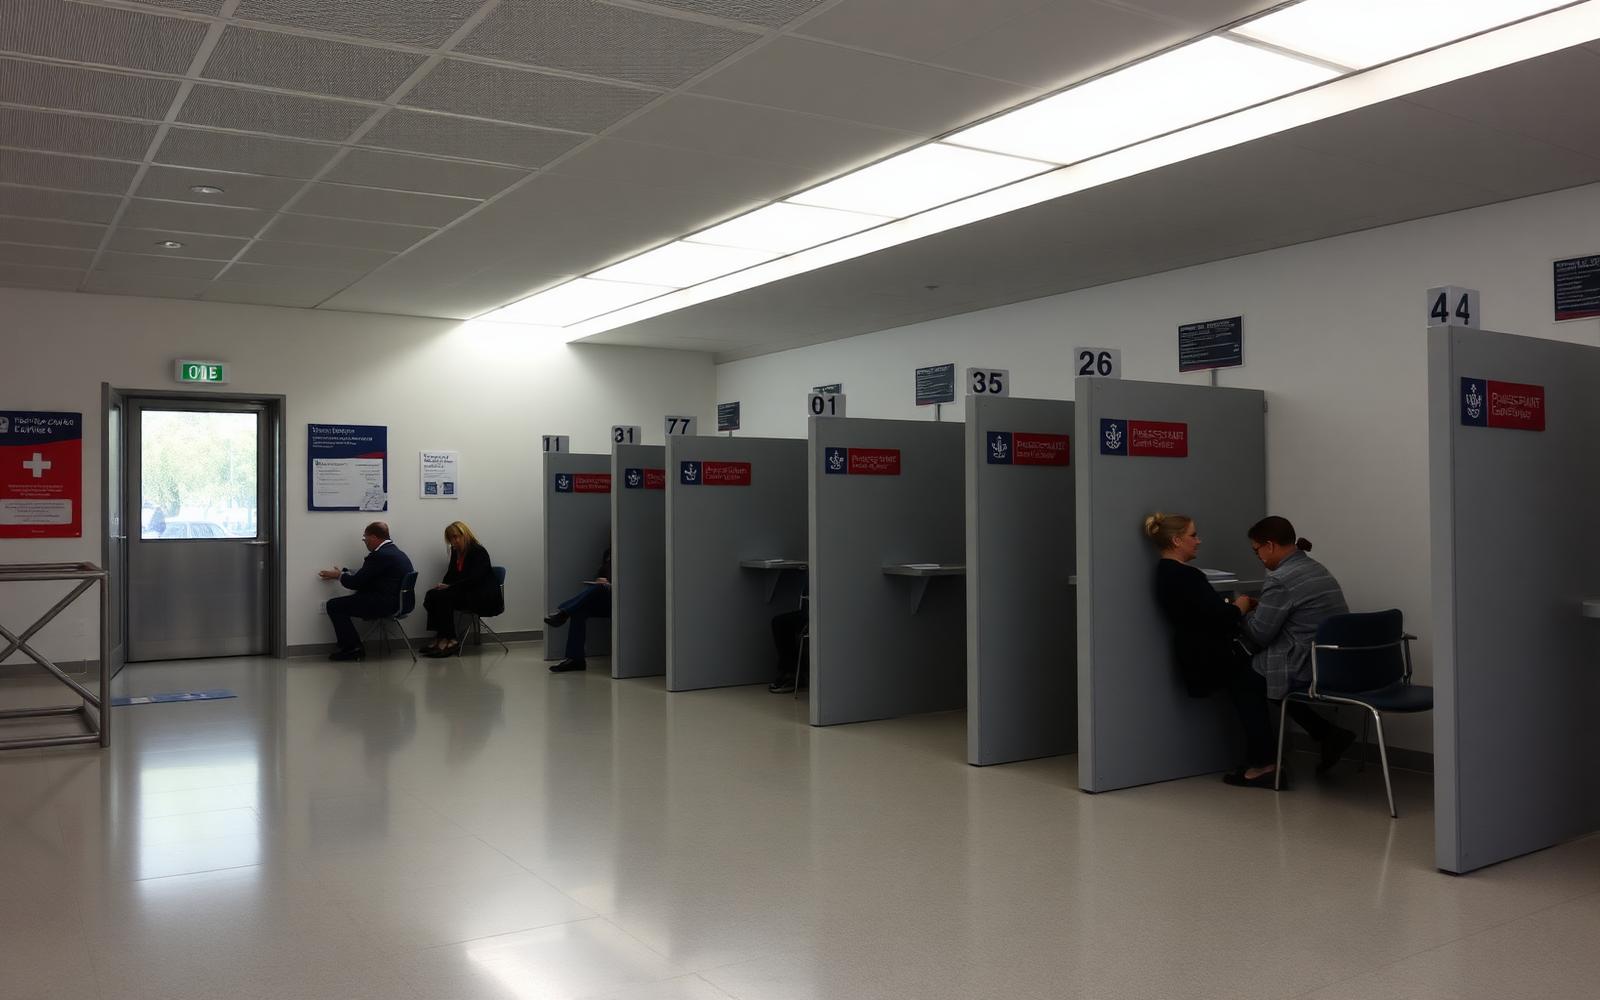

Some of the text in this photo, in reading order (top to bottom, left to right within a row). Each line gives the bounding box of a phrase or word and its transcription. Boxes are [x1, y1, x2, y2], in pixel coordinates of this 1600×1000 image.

[1431, 292, 1470, 325] 44
[1079, 351, 1112, 376] 26
[973, 371, 1002, 394] 35
[812, 395, 836, 415] 01
[667, 418, 691, 435] 77
